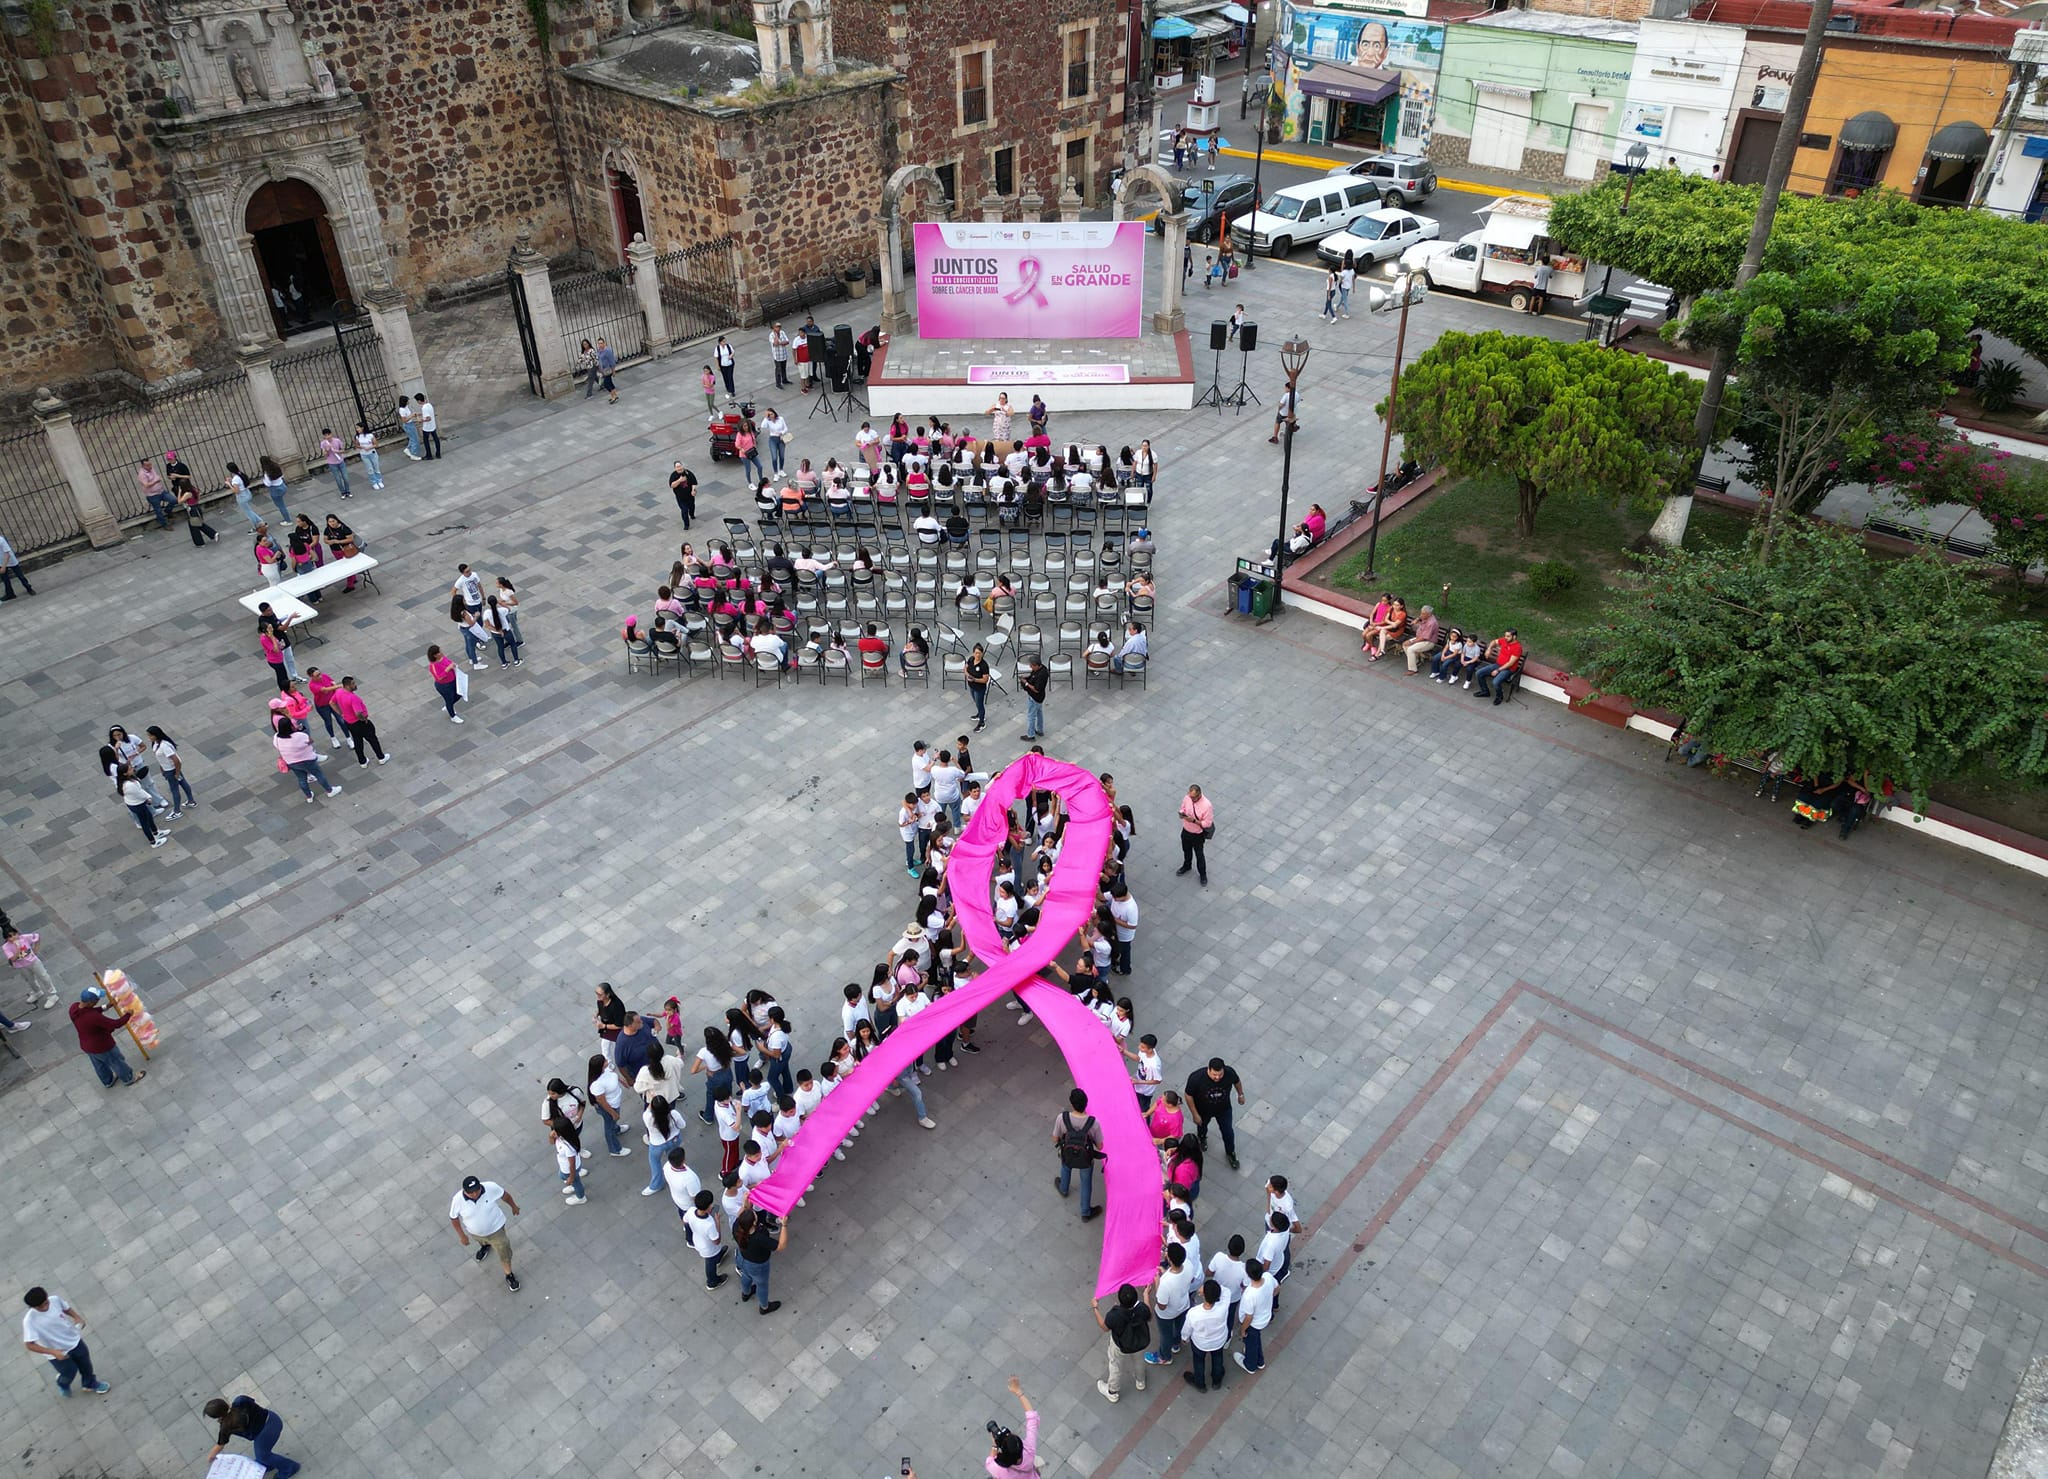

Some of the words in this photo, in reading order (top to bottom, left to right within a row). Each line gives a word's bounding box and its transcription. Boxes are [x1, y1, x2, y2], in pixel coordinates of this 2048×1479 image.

[932, 258, 998, 275] JUNTOS
[1072, 264, 1111, 274] SALUD
[1065, 274, 1131, 286] GRANDE
[932, 286, 948, 294] SOBRE
[949, 286, 955, 294] EL
[976, 286, 983, 294] DE
[983, 286, 998, 294] MAMA
